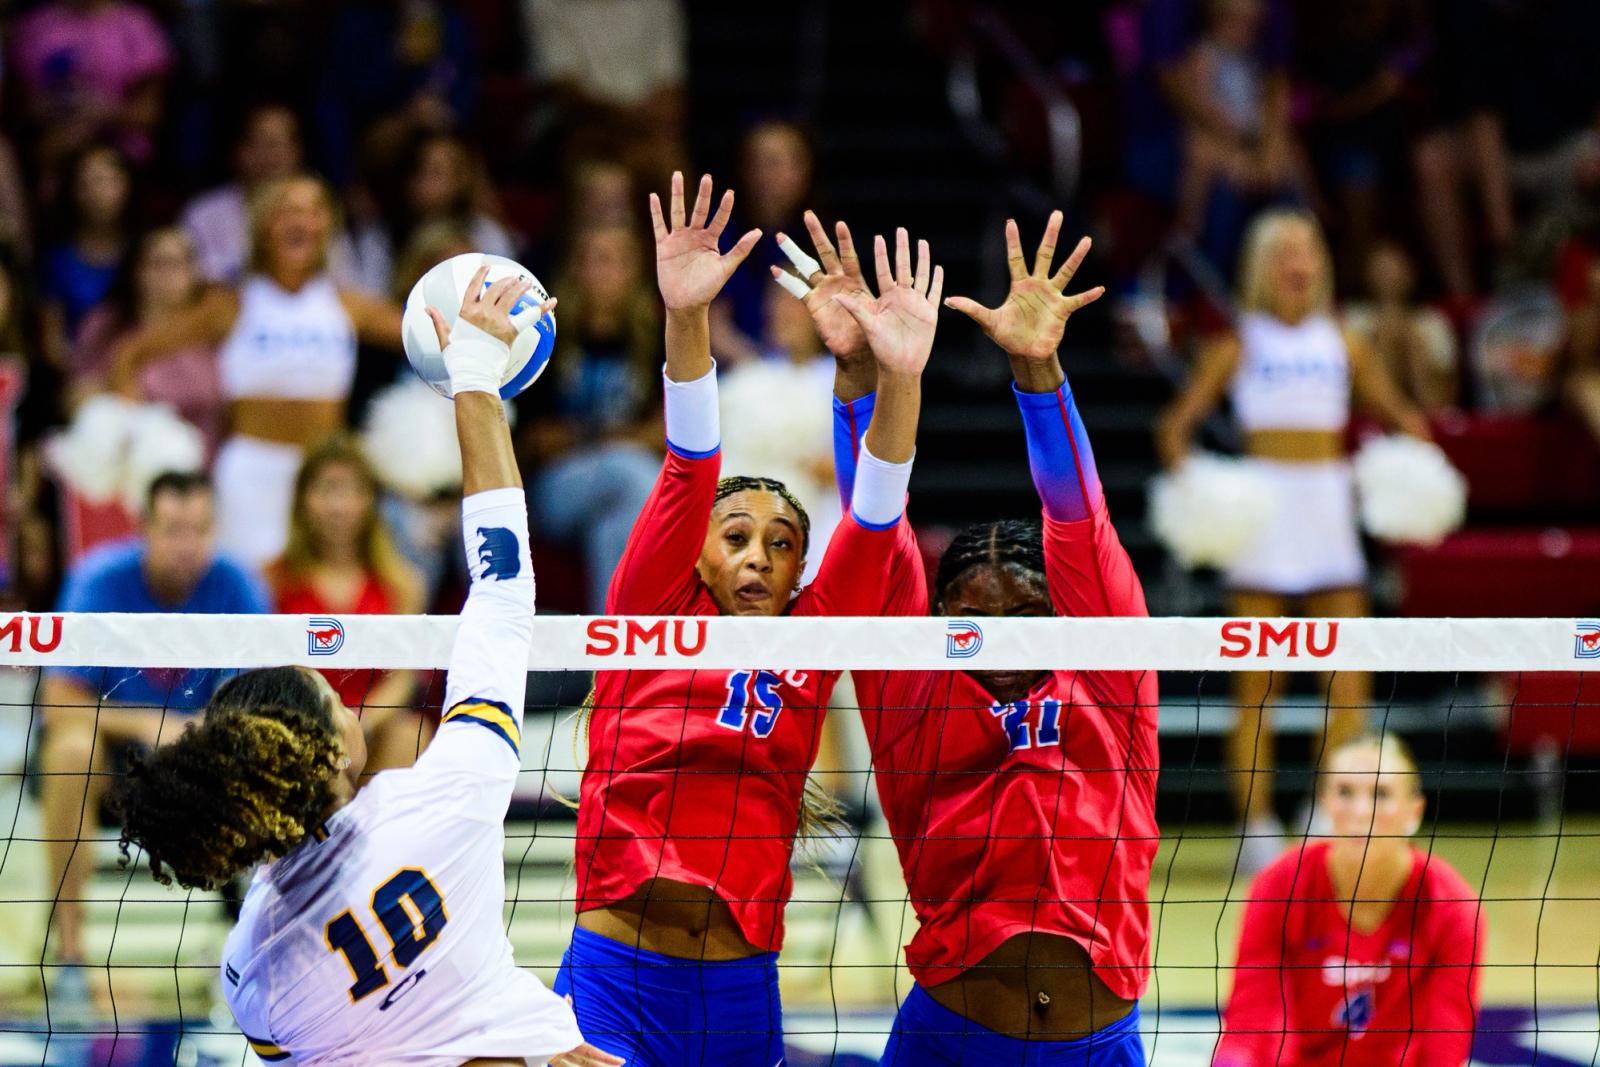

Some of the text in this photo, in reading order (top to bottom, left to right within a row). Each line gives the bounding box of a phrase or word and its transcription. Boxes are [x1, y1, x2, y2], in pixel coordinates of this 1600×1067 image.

[585, 618, 708, 657] SMU
[1220, 621, 1339, 658] SMU
[715, 669, 783, 738] 15
[989, 695, 1062, 755] 21
[323, 866, 449, 1004] 10
